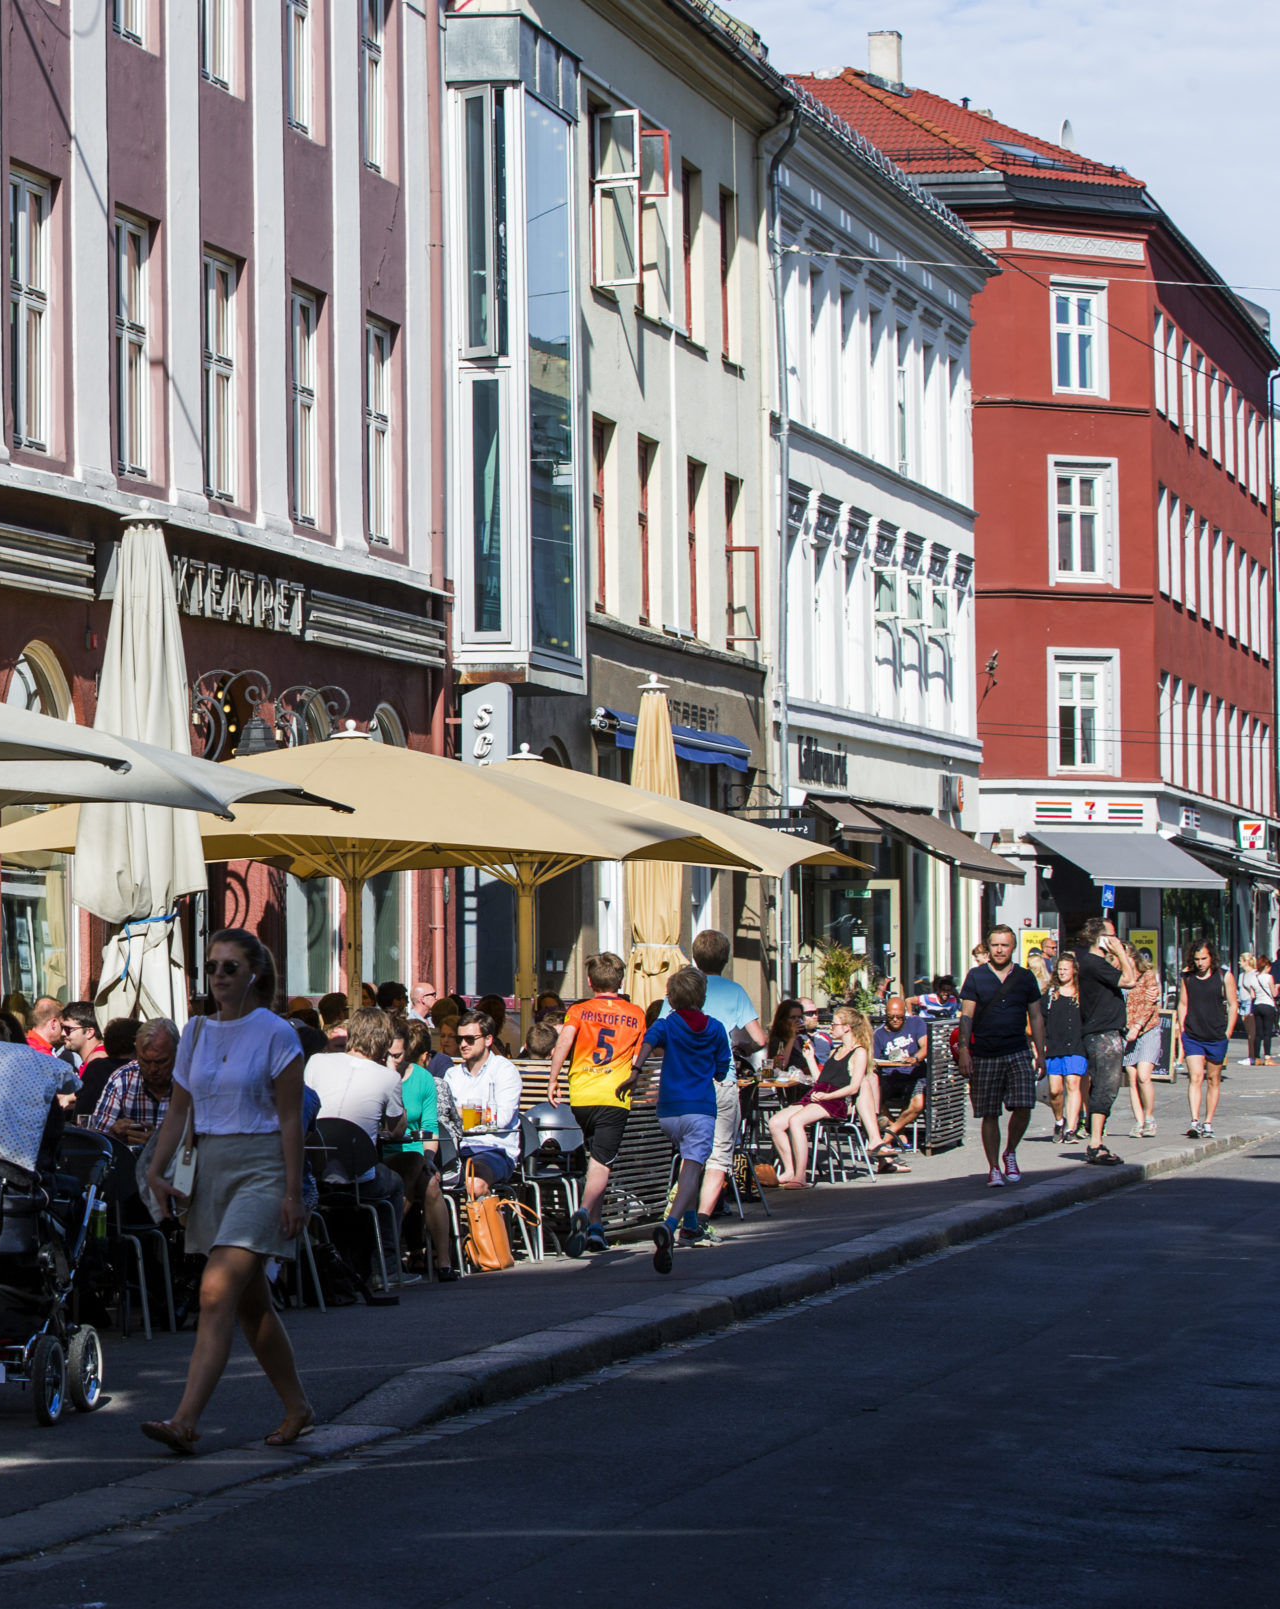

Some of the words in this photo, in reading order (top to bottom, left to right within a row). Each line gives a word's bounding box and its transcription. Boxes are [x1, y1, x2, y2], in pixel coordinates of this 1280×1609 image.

[170, 554, 306, 636] KTEATRET
[580, 1010, 639, 1029] KRISTOFFER
[592, 1027, 616, 1066] 5
